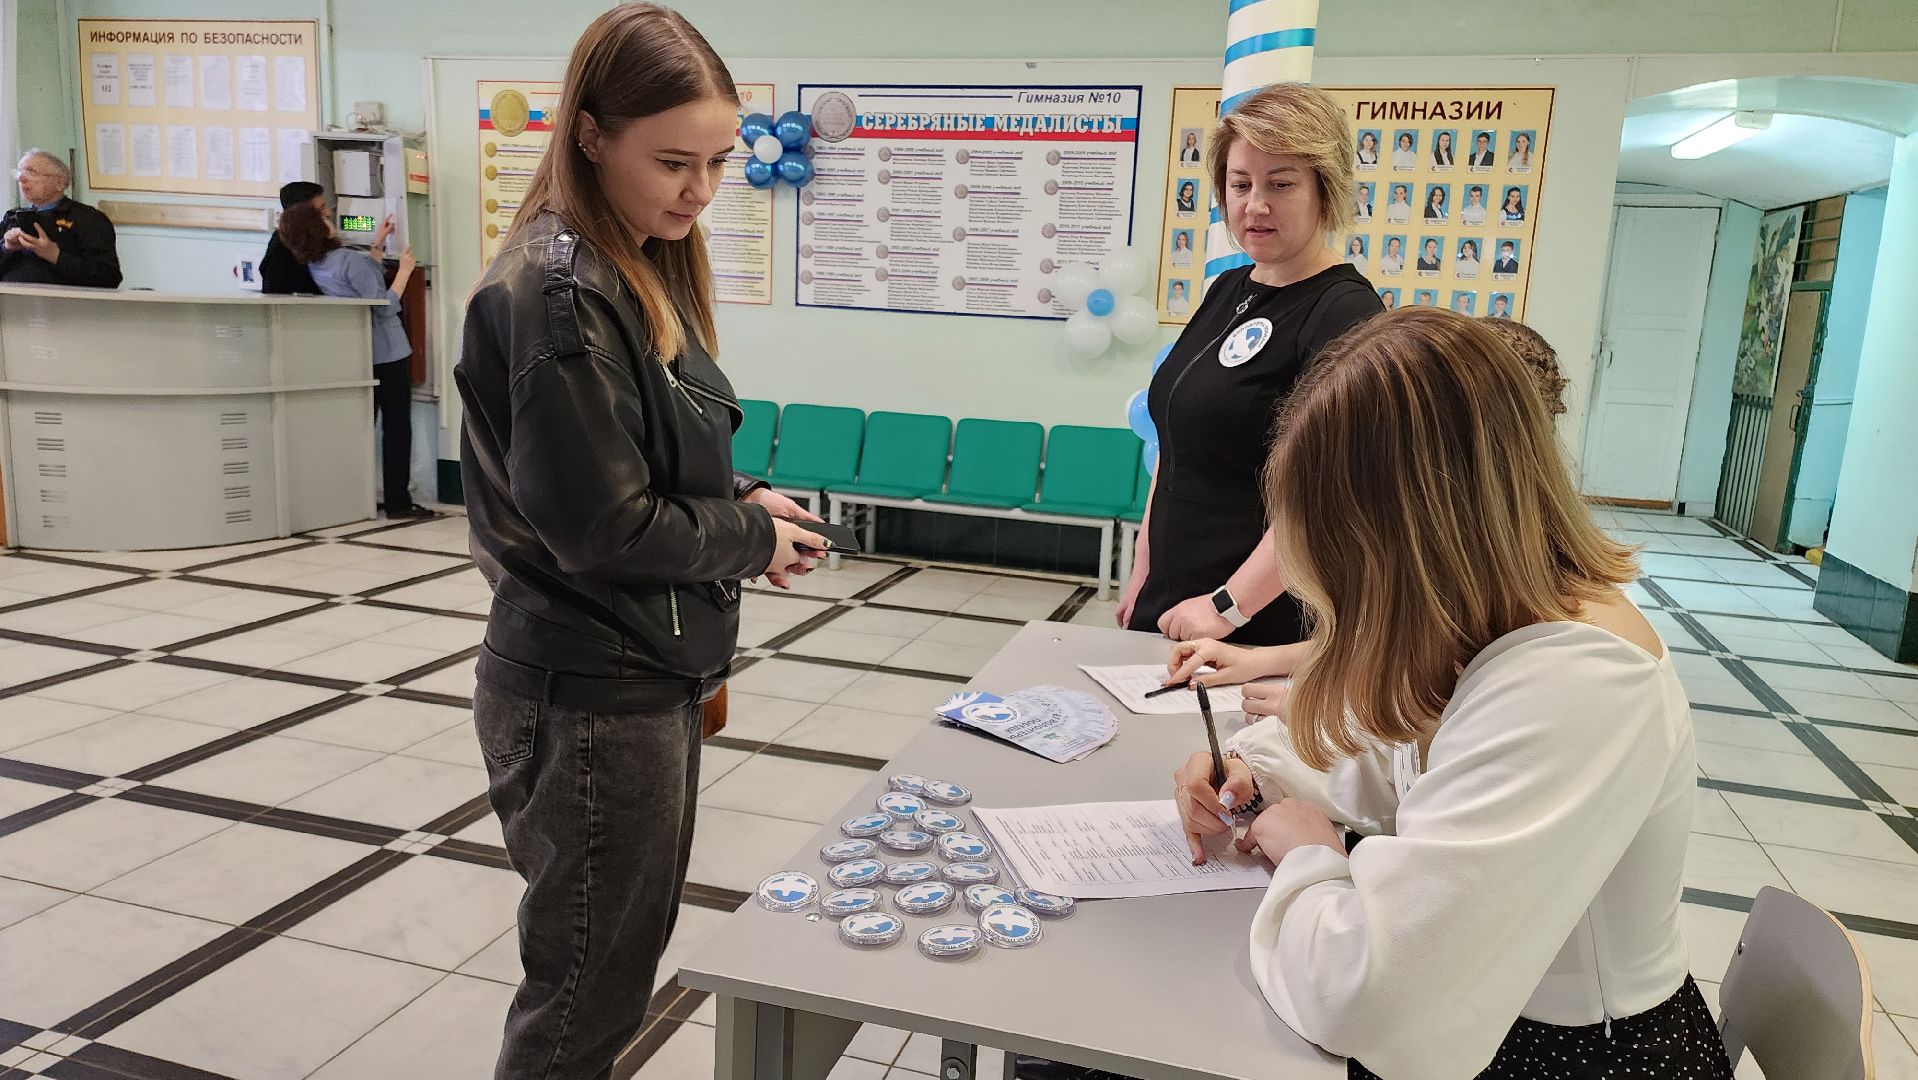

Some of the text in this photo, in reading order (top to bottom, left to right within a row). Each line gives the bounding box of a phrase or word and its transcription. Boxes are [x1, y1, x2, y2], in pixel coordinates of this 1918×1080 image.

[90, 31, 303, 45] ИНФОРМАЦИЯ ПО БЕЗОПАСНОСТИ
[1018, 91, 1122, 104] Гимназия №10
[1355, 100, 1503, 120] ГИМНАЗИИ
[862, 111, 1123, 137] СЕРЕБРЯНЫЕ МЕДАЛИСТЫ
